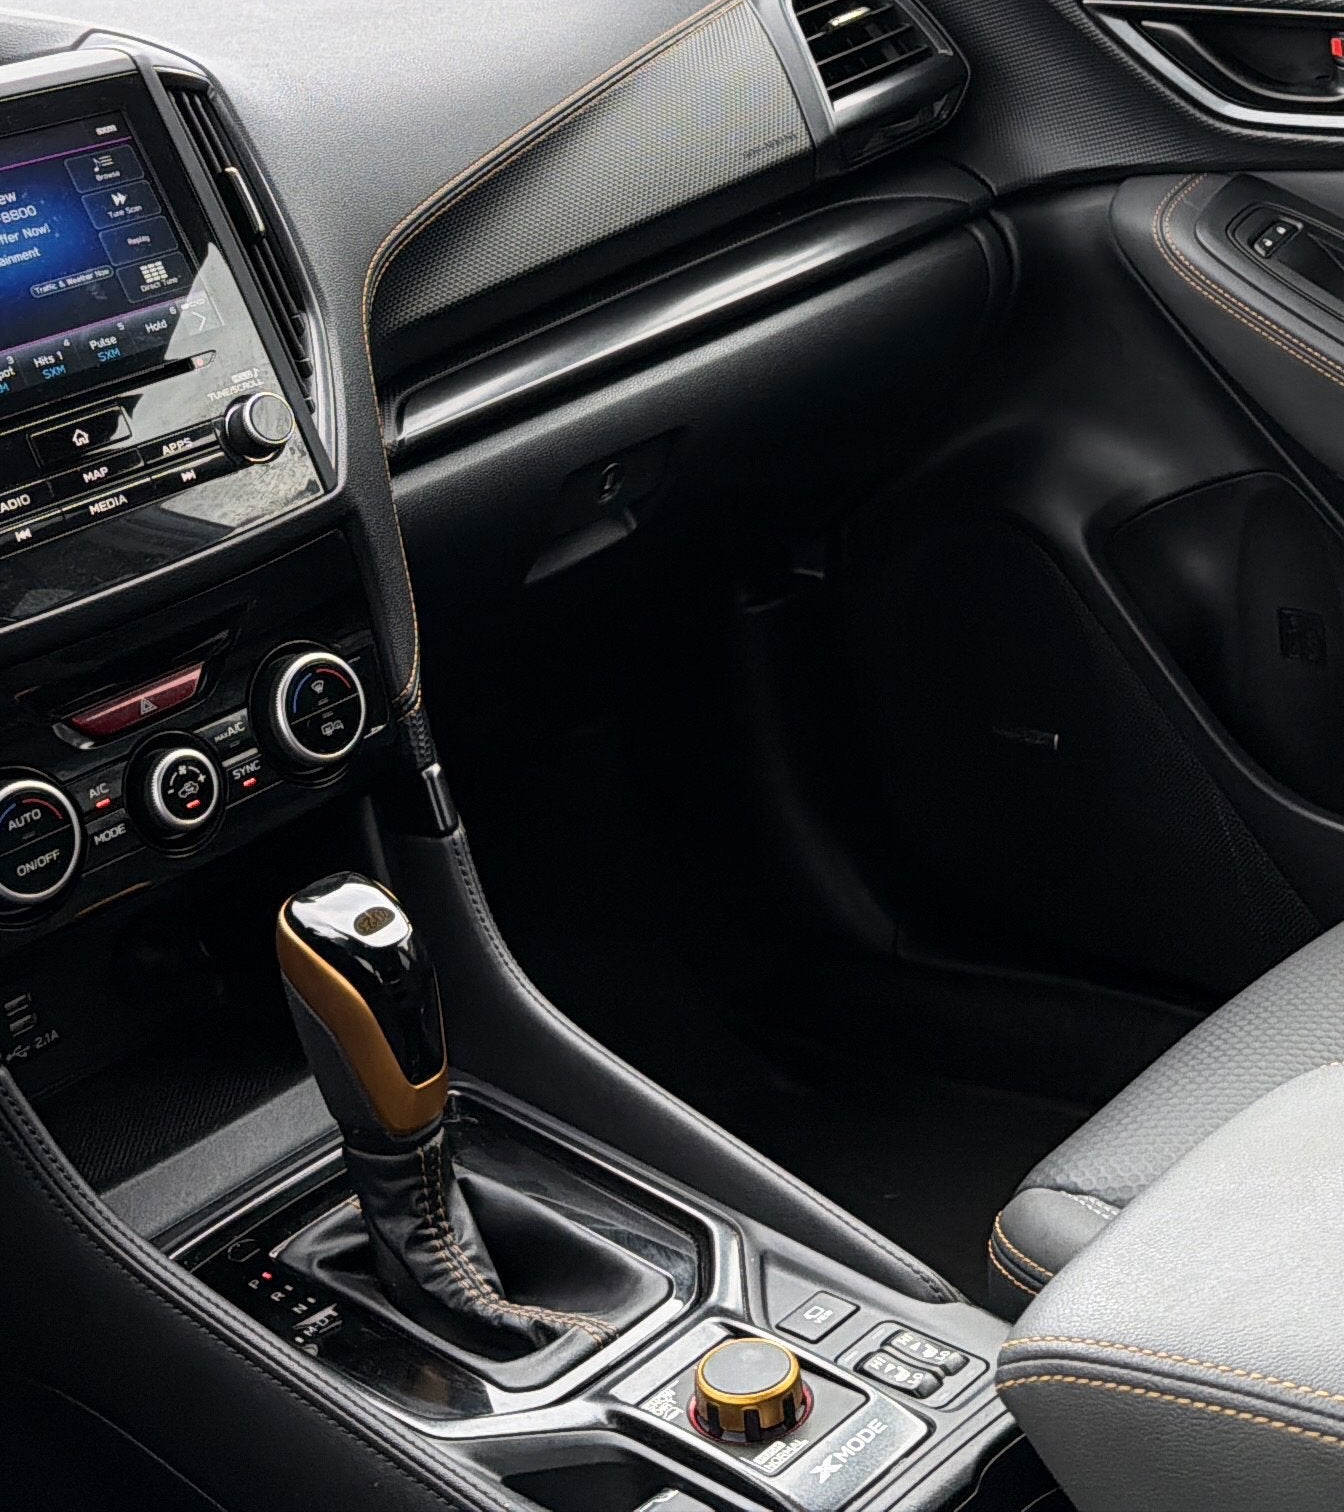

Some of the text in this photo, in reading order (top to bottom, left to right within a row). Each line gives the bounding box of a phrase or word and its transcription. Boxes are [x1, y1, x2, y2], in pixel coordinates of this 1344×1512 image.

[95, 170, 121, 182] Browse
[107, 205, 143, 219] Tune Scan
[22, 223, 52, 240] Now!
[126, 234, 152, 247] Replay
[34, 281, 58, 295] Traffic
[67, 273, 93, 286] Weather
[94, 268, 110, 279] Now
[140, 276, 178, 293] Direct Tune
[169, 306, 177, 315] 6
[116, 322, 125, 331] 5
[144, 319, 169, 334] Hold
[63, 338, 71, 347] 4
[89, 335, 118, 351] Pulse
[6, 355, 15, 365] 3
[33, 350, 64, 368] Hits 1
[96, 347, 122, 363] SXM
[41, 364, 67, 380] SXM
[207, 378, 265, 402] TUNE/SCROLL
[161, 436, 193, 457] APPS
[82, 465, 109, 485] MAP
[88, 493, 129, 517] MEDIA
[214, 721, 246, 743] MAX A/C
[232, 759, 261, 780] SYNC
[89, 782, 110, 799] A/C
[8, 808, 42, 832] AUTO
[93, 822, 127, 846] MODE
[16, 848, 61, 878] ON/OFF
[34, 1029, 60, 1049] 2.1A
[248, 1279, 260, 1289] P
[270, 1291, 286, 1302] R
[291, 1303, 308, 1314] N
